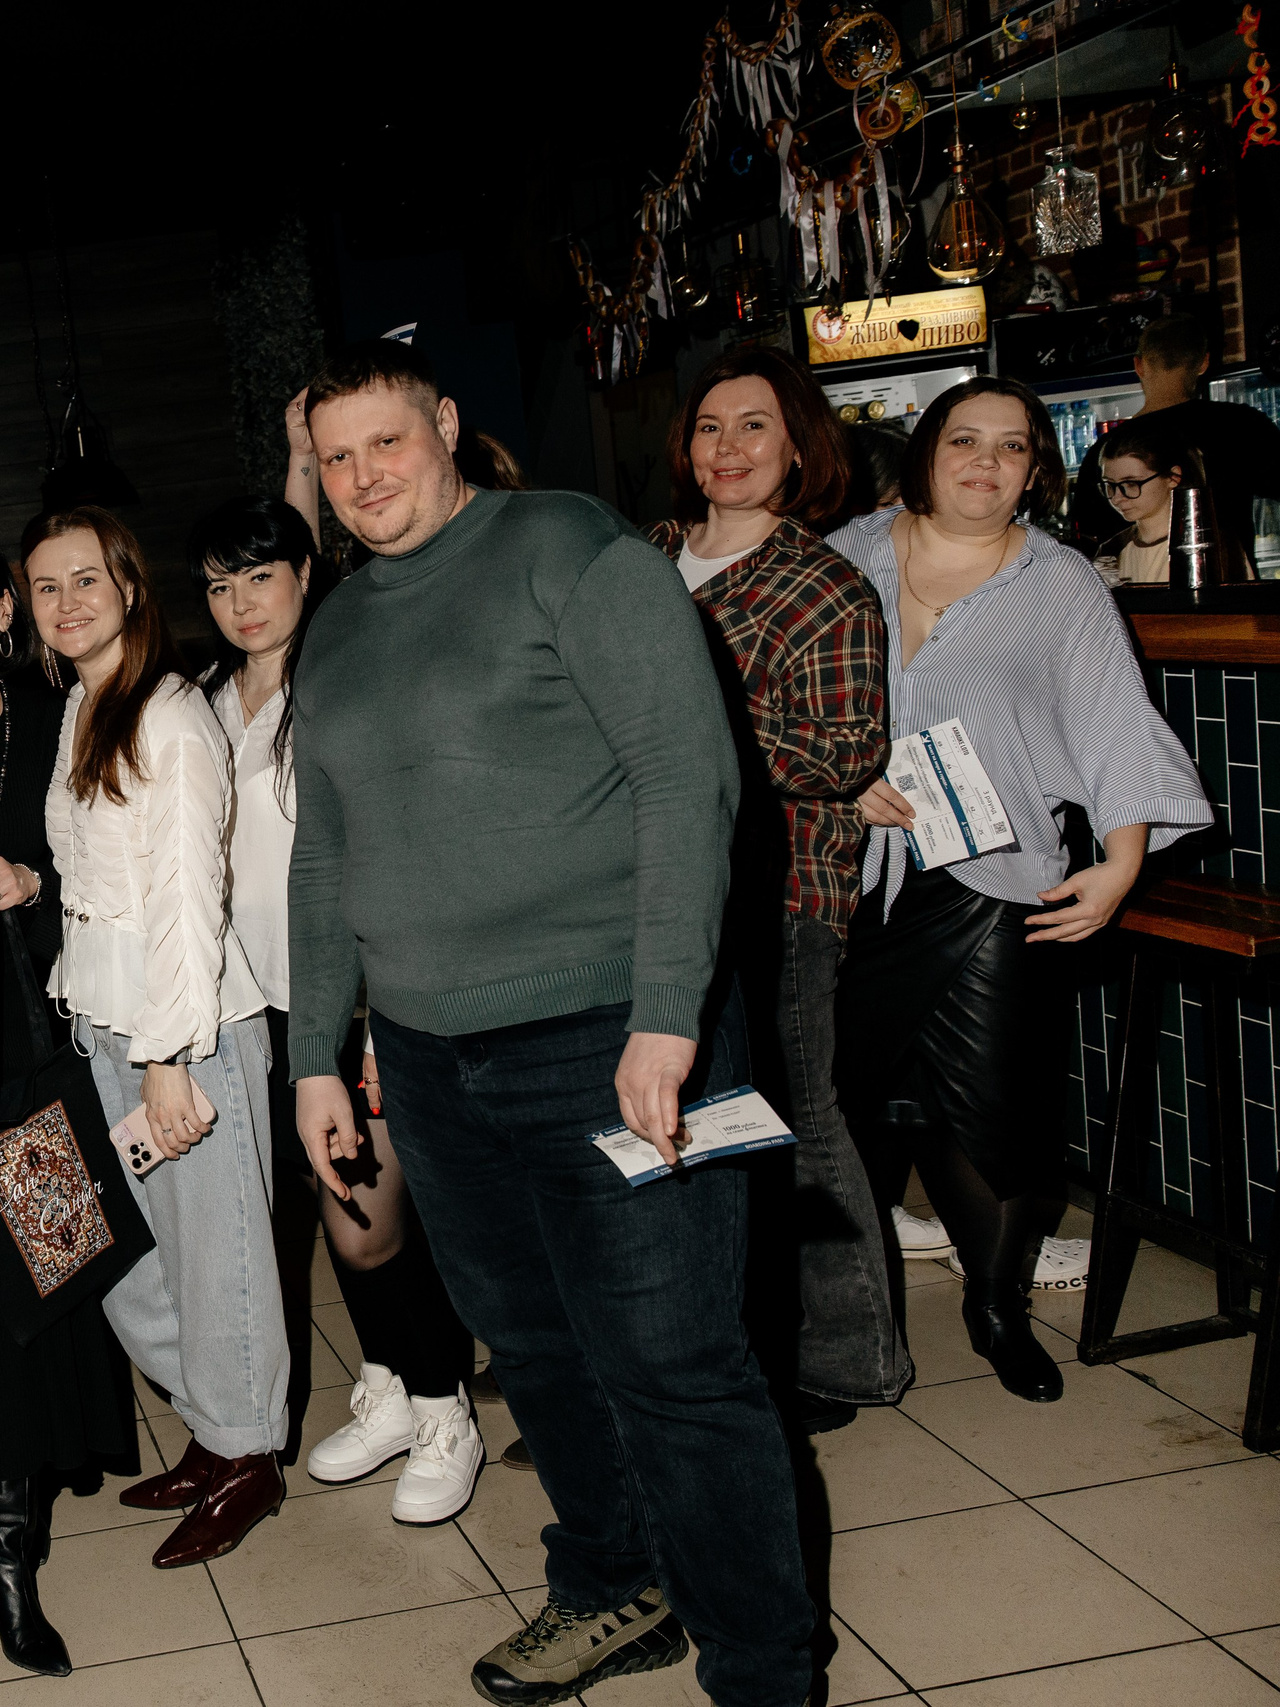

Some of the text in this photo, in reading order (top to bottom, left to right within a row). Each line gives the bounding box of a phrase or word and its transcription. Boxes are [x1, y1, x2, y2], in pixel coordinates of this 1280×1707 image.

[920, 309, 980, 327] РАЗЛИВНОЕ
[850, 319, 981, 348] ЖИВО ПИВО
[951, 725, 964, 744] KARAOKE
[959, 743, 969, 755] LOTO
[984, 795, 998, 815] раунд
[924, 822, 933, 835] 1000
[906, 831, 921, 861] BOARDING PASS
[723, 1124, 740, 1132] 1000
[745, 1141, 771, 1149] BOARDING
[1032, 1274, 1089, 1290] crocs
